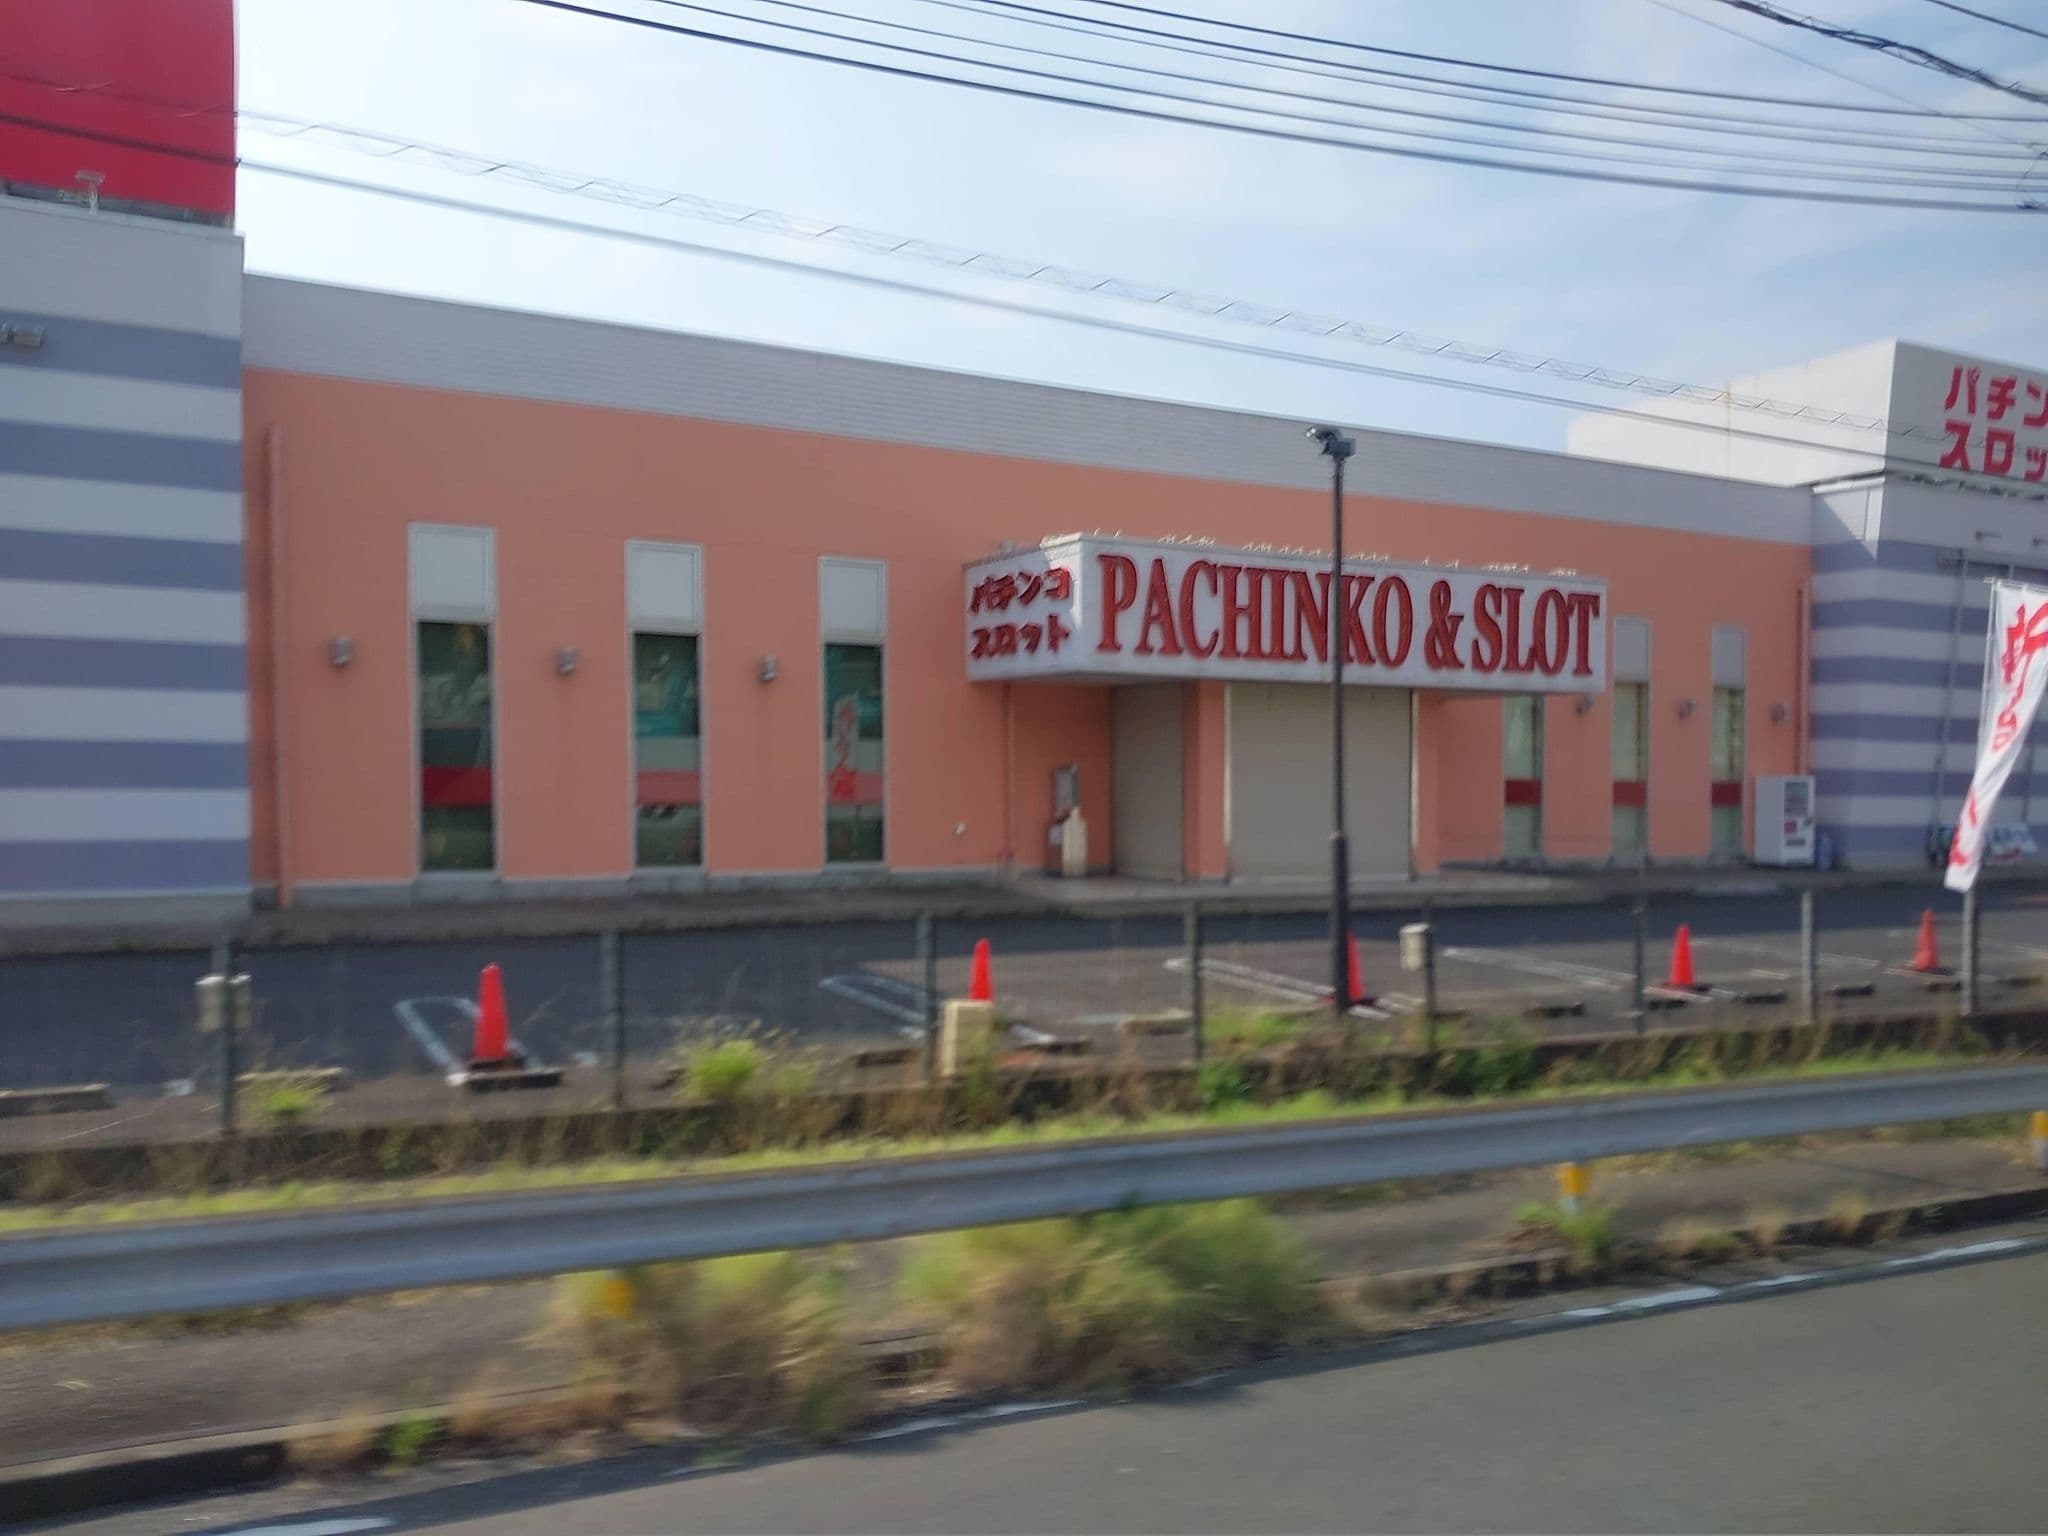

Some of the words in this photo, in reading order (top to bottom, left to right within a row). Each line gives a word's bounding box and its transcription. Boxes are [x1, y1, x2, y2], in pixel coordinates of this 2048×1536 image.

[970, 567, 1070, 614] パチンコ
[1096, 554, 1413, 669] PACHINKO
[1424, 580, 1464, 672] &
[1472, 583, 1600, 677] SLOT
